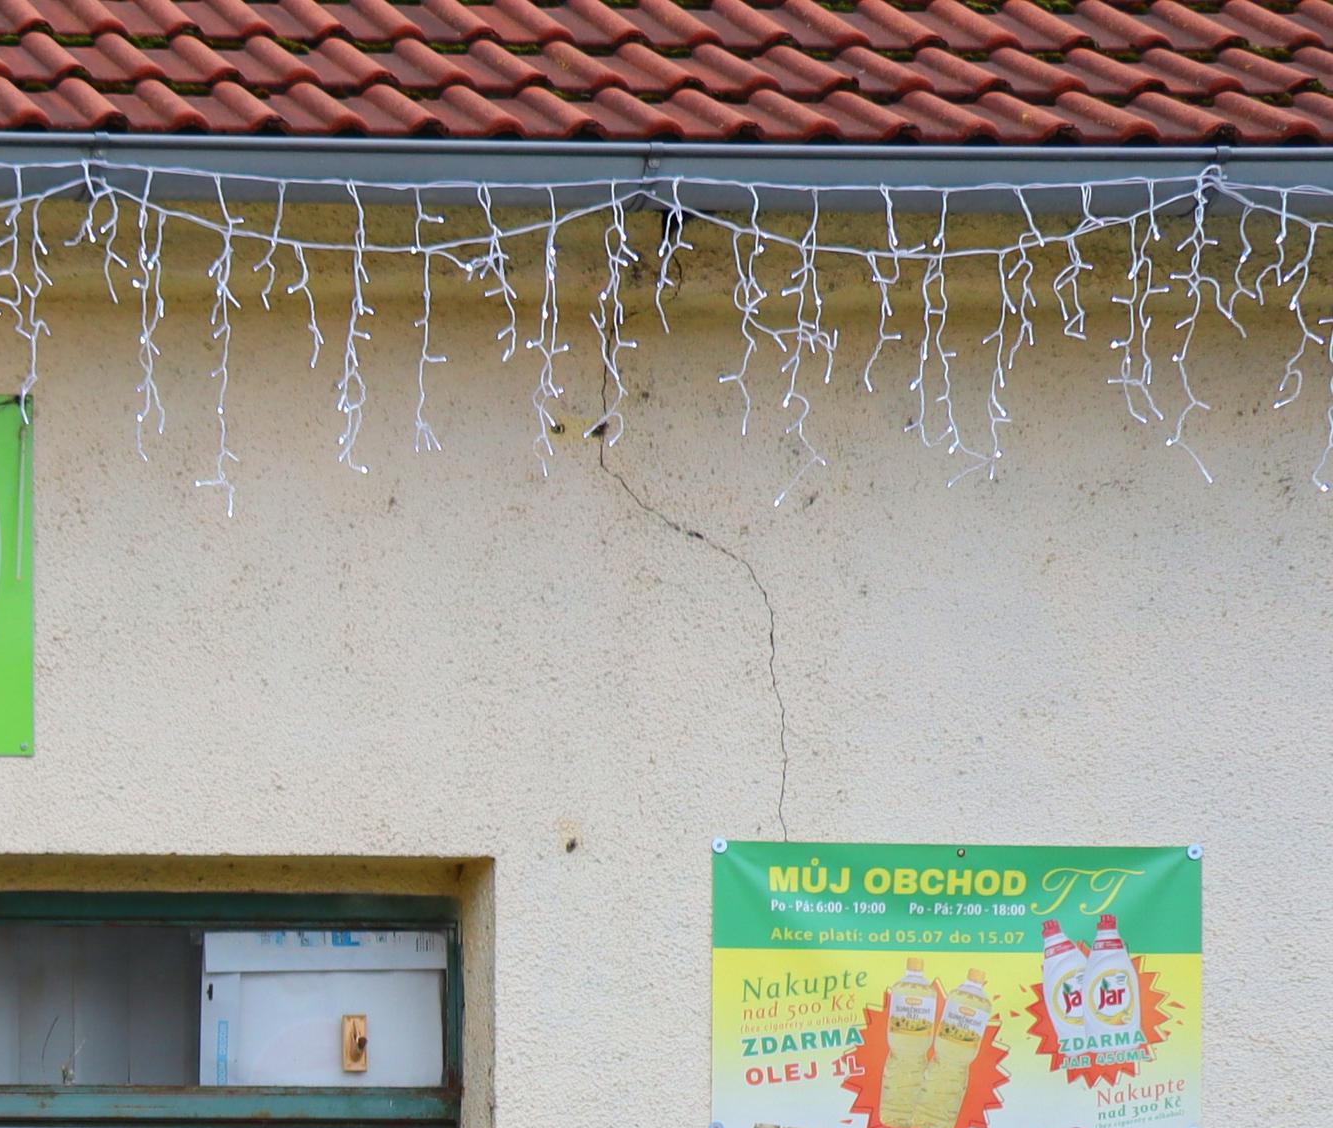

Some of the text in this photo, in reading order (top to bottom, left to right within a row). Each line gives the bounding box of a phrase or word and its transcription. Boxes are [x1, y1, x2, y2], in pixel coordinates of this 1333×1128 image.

[768, 857, 851, 893] MŮJ
[864, 867, 1028, 896] OBCHOD
[771, 898, 1026, 917] Po Pá: 6:00 19:00 Po Pá: 7:00 18:00
[771, 927, 1025, 946] Akce platí: od 05.07 do 15.07
[742, 969, 868, 1003] Nakupte
[743, 993, 856, 1021] nad 500 Kč
[741, 1027, 863, 1057] ZDARMA
[1059, 1030, 1147, 1052] ZDARMA
[745, 1055, 865, 1086] OLEJ 1L
[1061, 1049, 1152, 1070] JAR 450ML
[1097, 1079, 1185, 1108] Nakupte
[1098, 1095, 1182, 1121] nad 300 Kč
